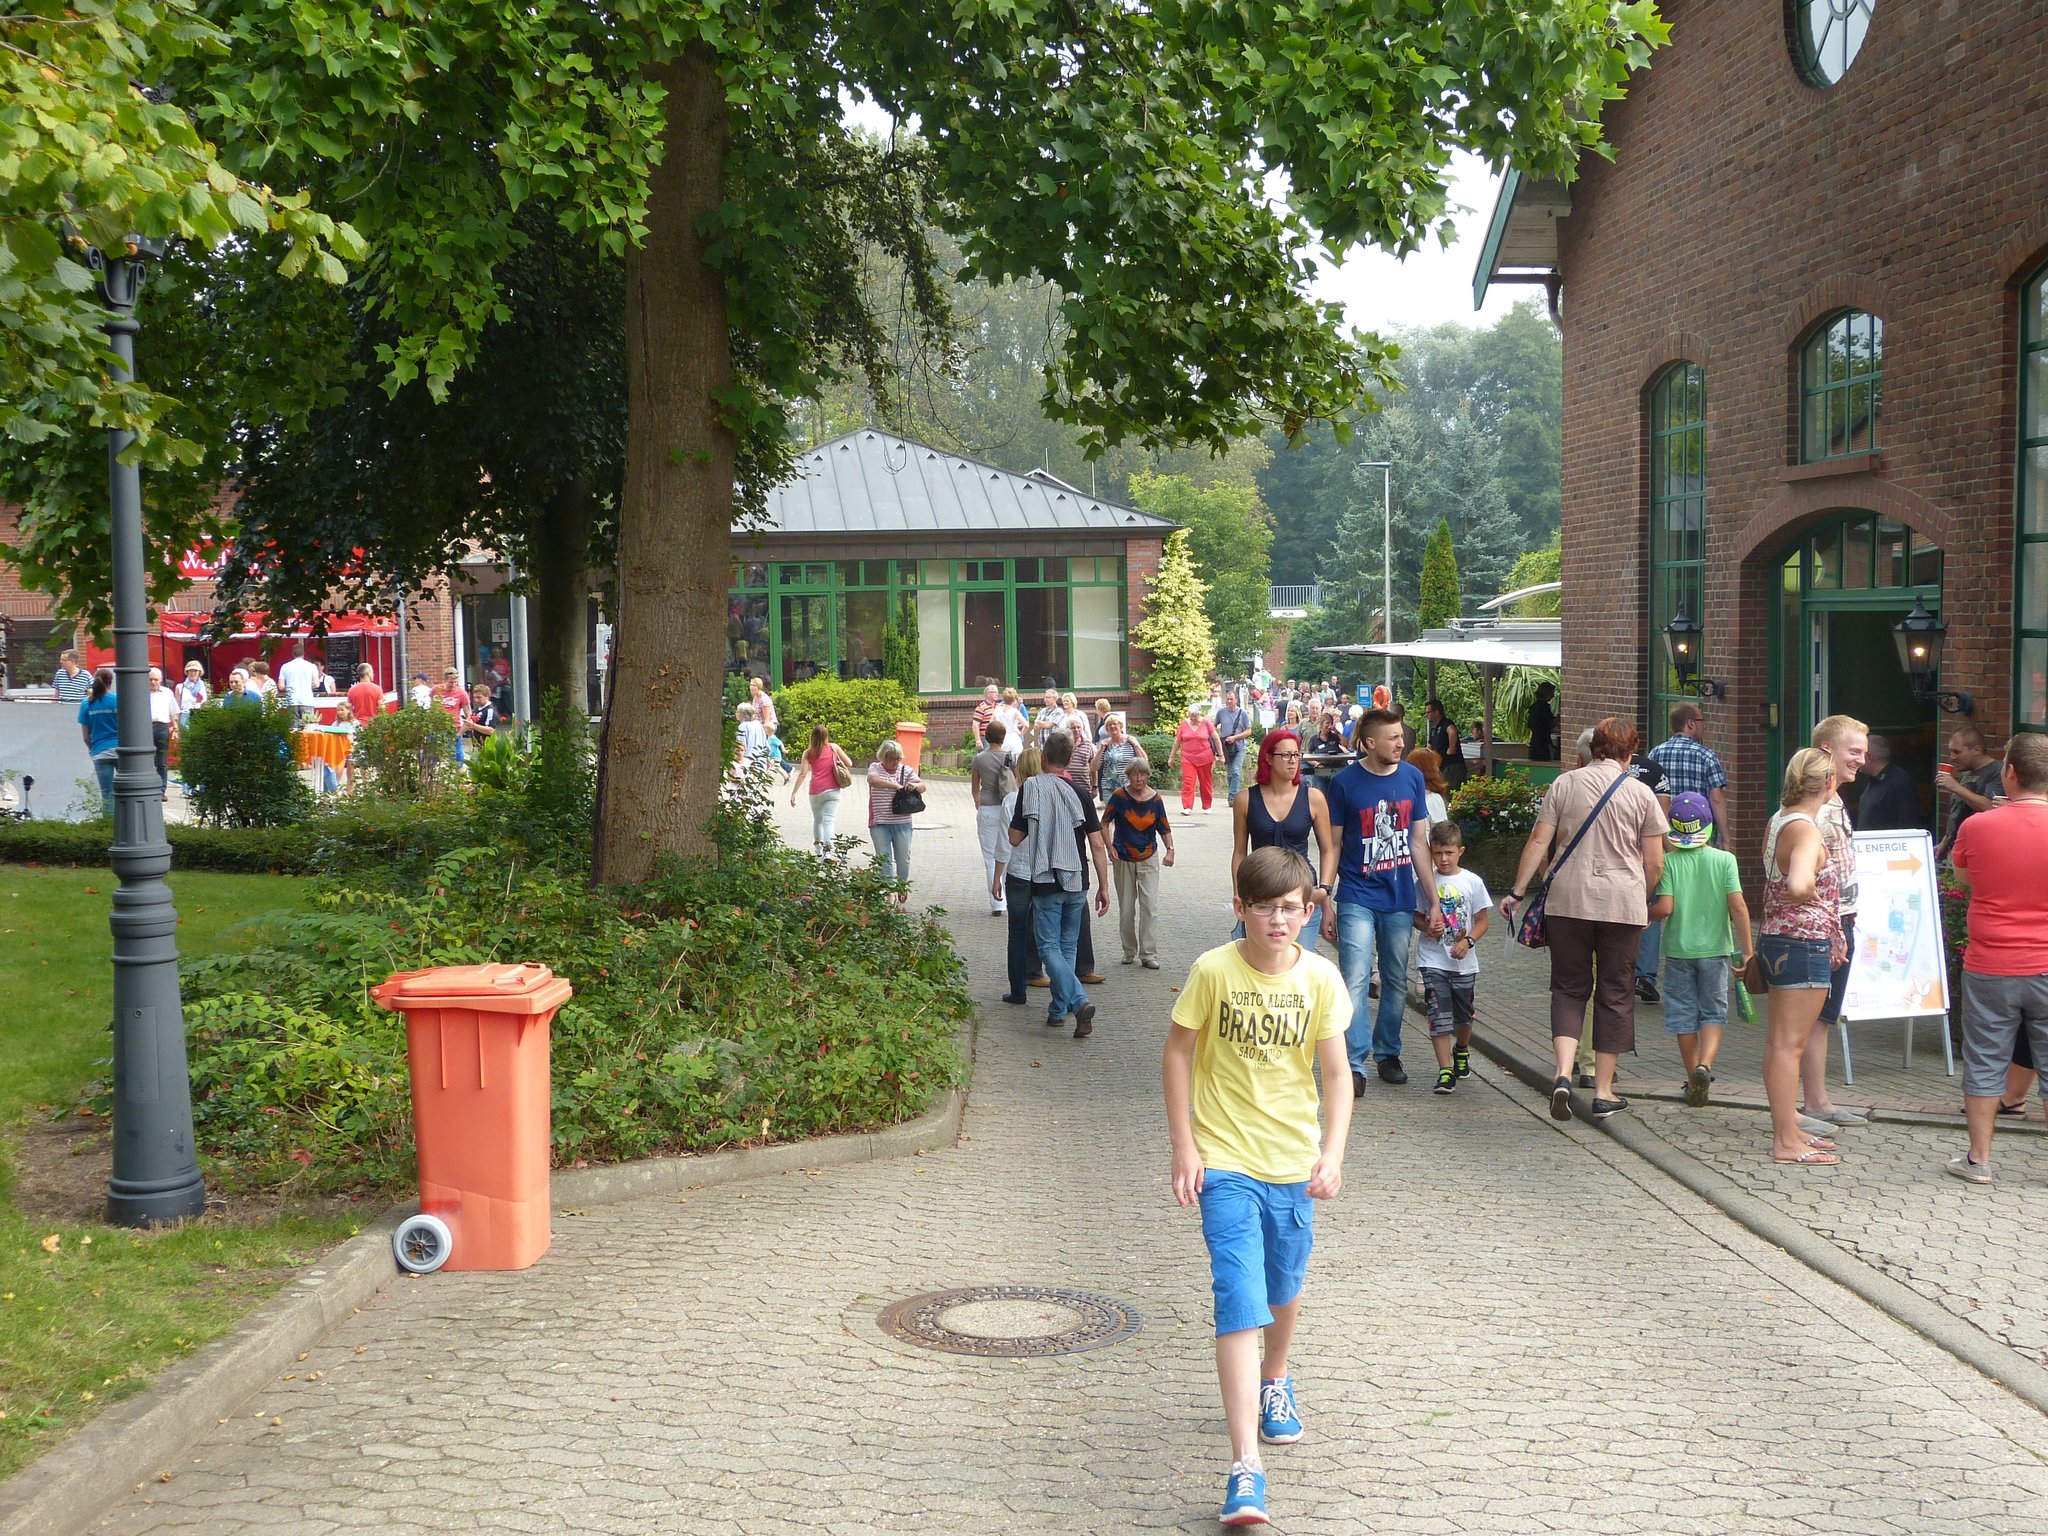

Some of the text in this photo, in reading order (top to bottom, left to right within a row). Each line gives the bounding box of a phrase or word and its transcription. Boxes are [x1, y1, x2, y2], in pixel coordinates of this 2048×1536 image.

[1865, 842, 1908, 853] ENERGIE
[1230, 991, 1305, 1009] PORTO ALEGRE
